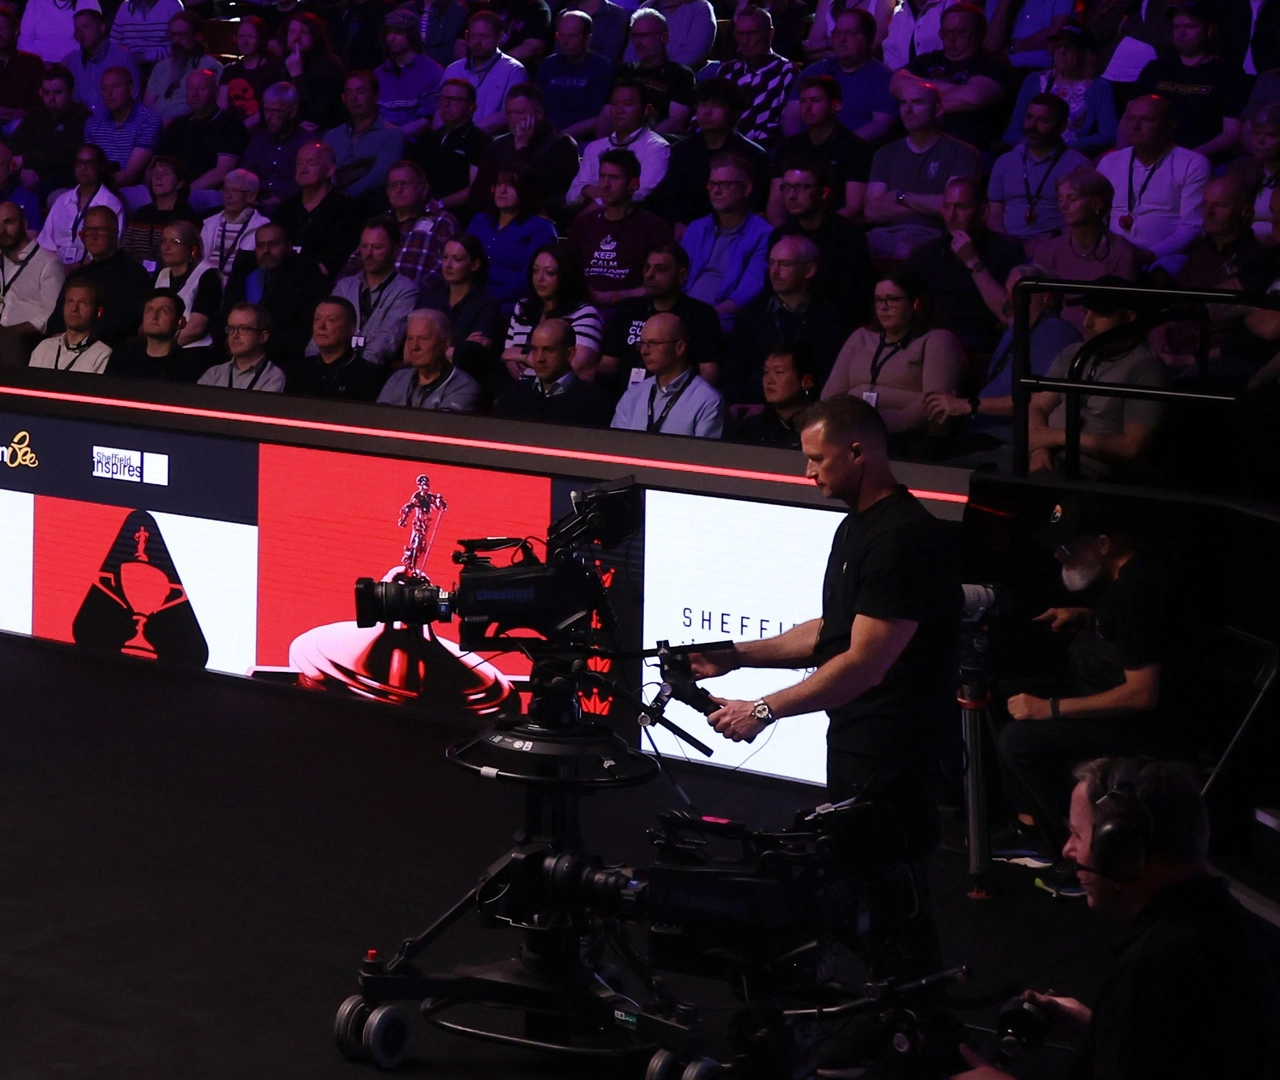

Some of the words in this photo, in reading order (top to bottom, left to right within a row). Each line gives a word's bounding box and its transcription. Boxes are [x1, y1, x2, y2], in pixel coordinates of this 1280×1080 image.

[594, 251, 617, 259] KEEP
[93, 457, 142, 478] inspires
[96, 451, 132, 466] Sheffield
[683, 607, 800, 639] SHEFFI
